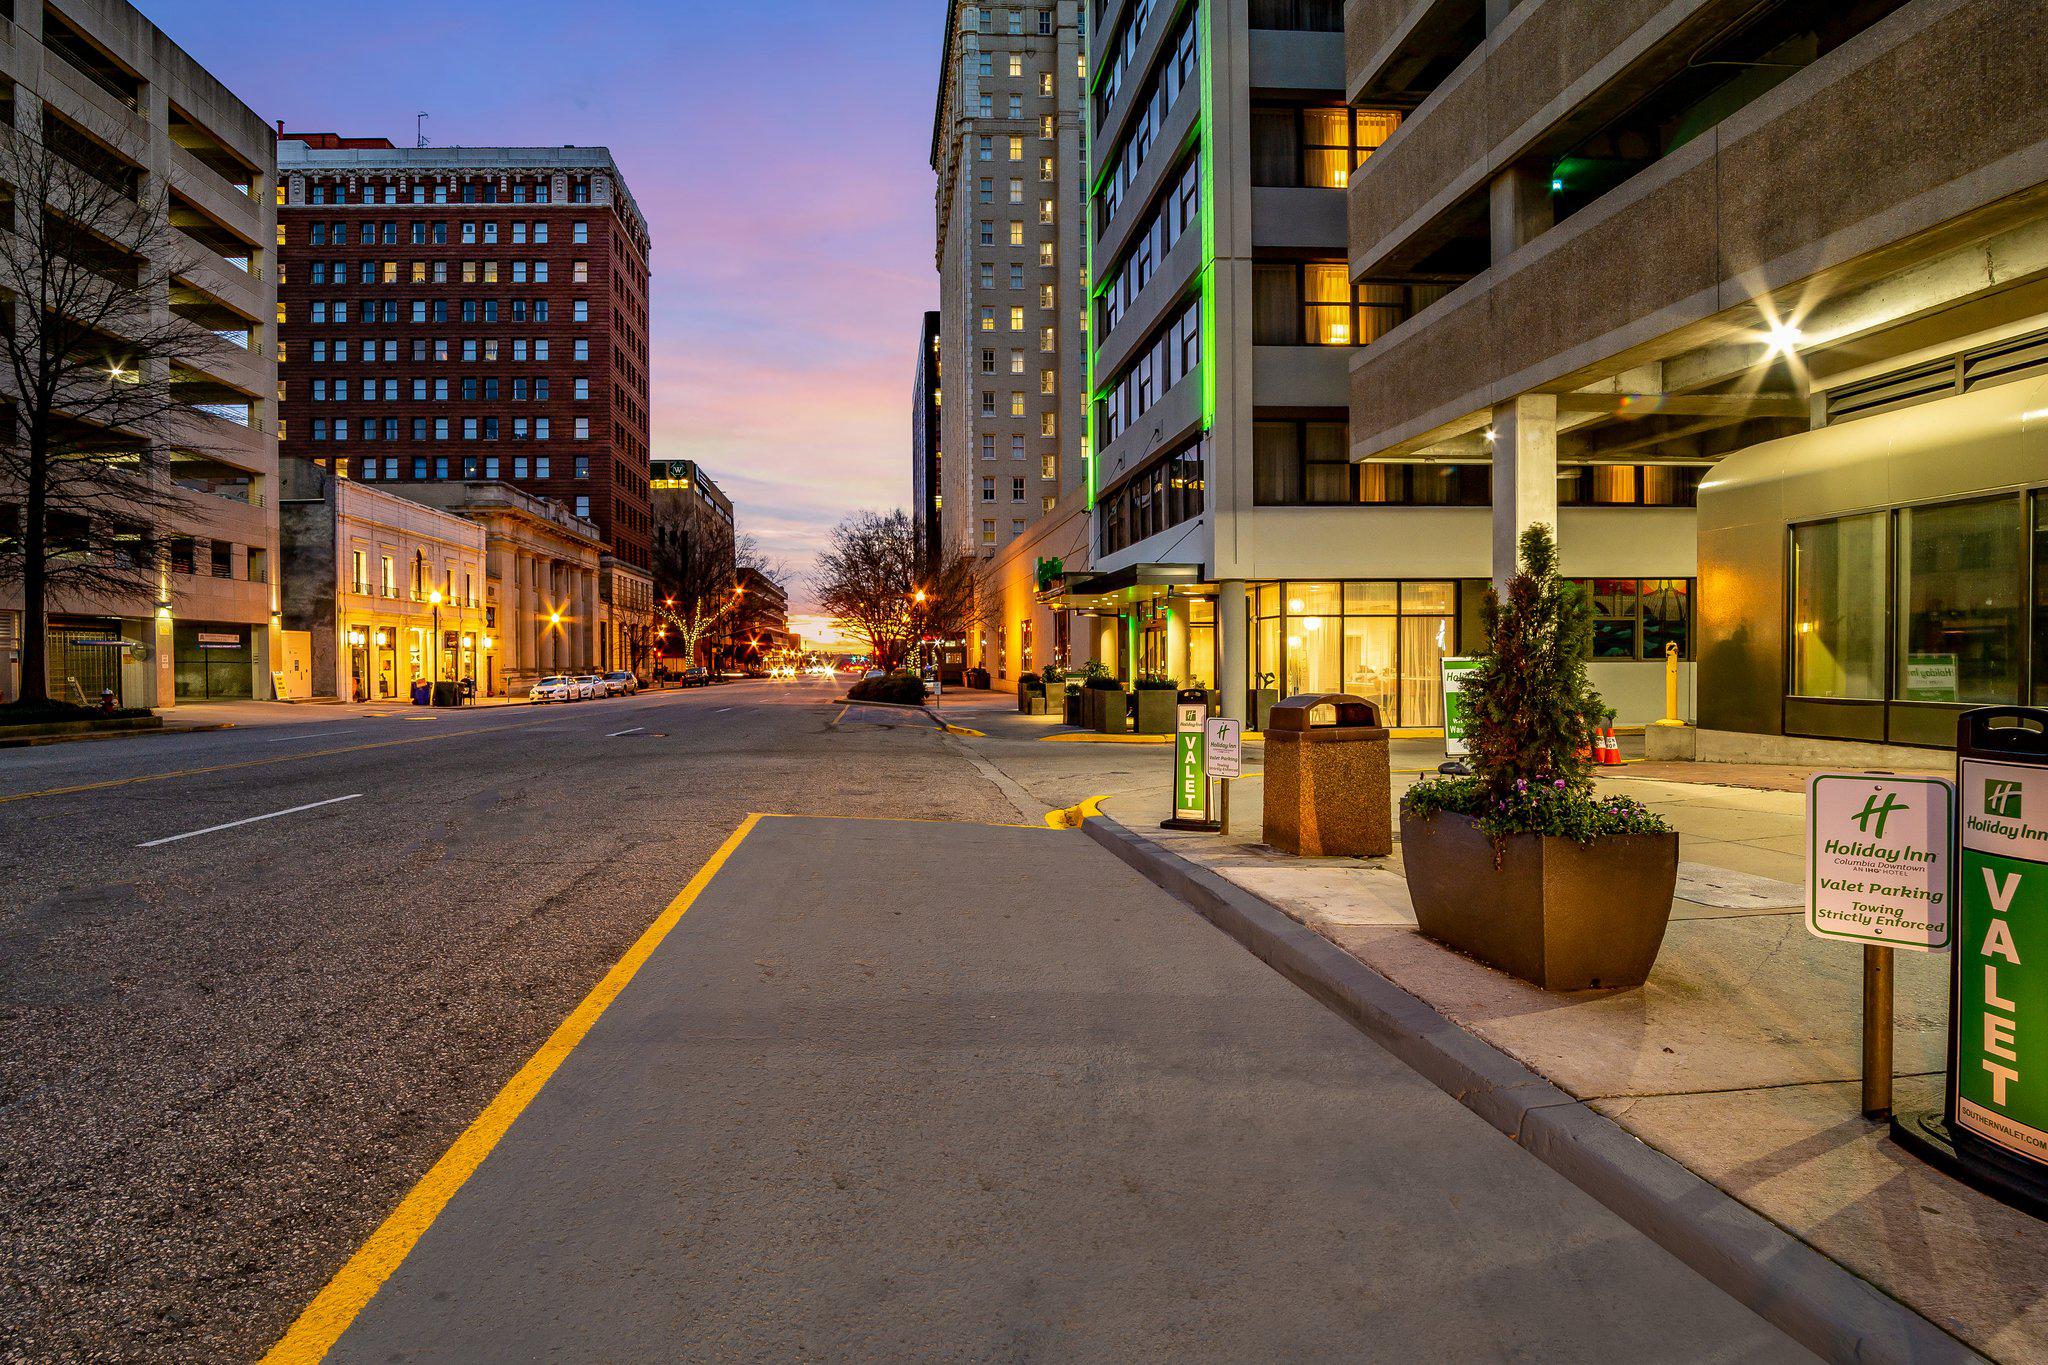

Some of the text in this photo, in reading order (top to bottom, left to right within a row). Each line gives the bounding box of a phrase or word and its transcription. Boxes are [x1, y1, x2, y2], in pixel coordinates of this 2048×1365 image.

[1185, 736, 1197, 808] VALET
[1967, 815, 2048, 842] Holiday Inn
[1824, 839, 1937, 864] Holiday Inn
[1834, 858, 1926, 873] Columbia Downtown
[1883, 869, 1909, 877] HOTEL
[1820, 878, 1944, 905] Valet Parking
[1817, 908, 1944, 933] Strictly Enforced
[1852, 901, 1904, 918] Towing
[1980, 866, 2023, 1108] VALET
[1961, 1106, 2047, 1150] SOUTHERNVALET.COM
